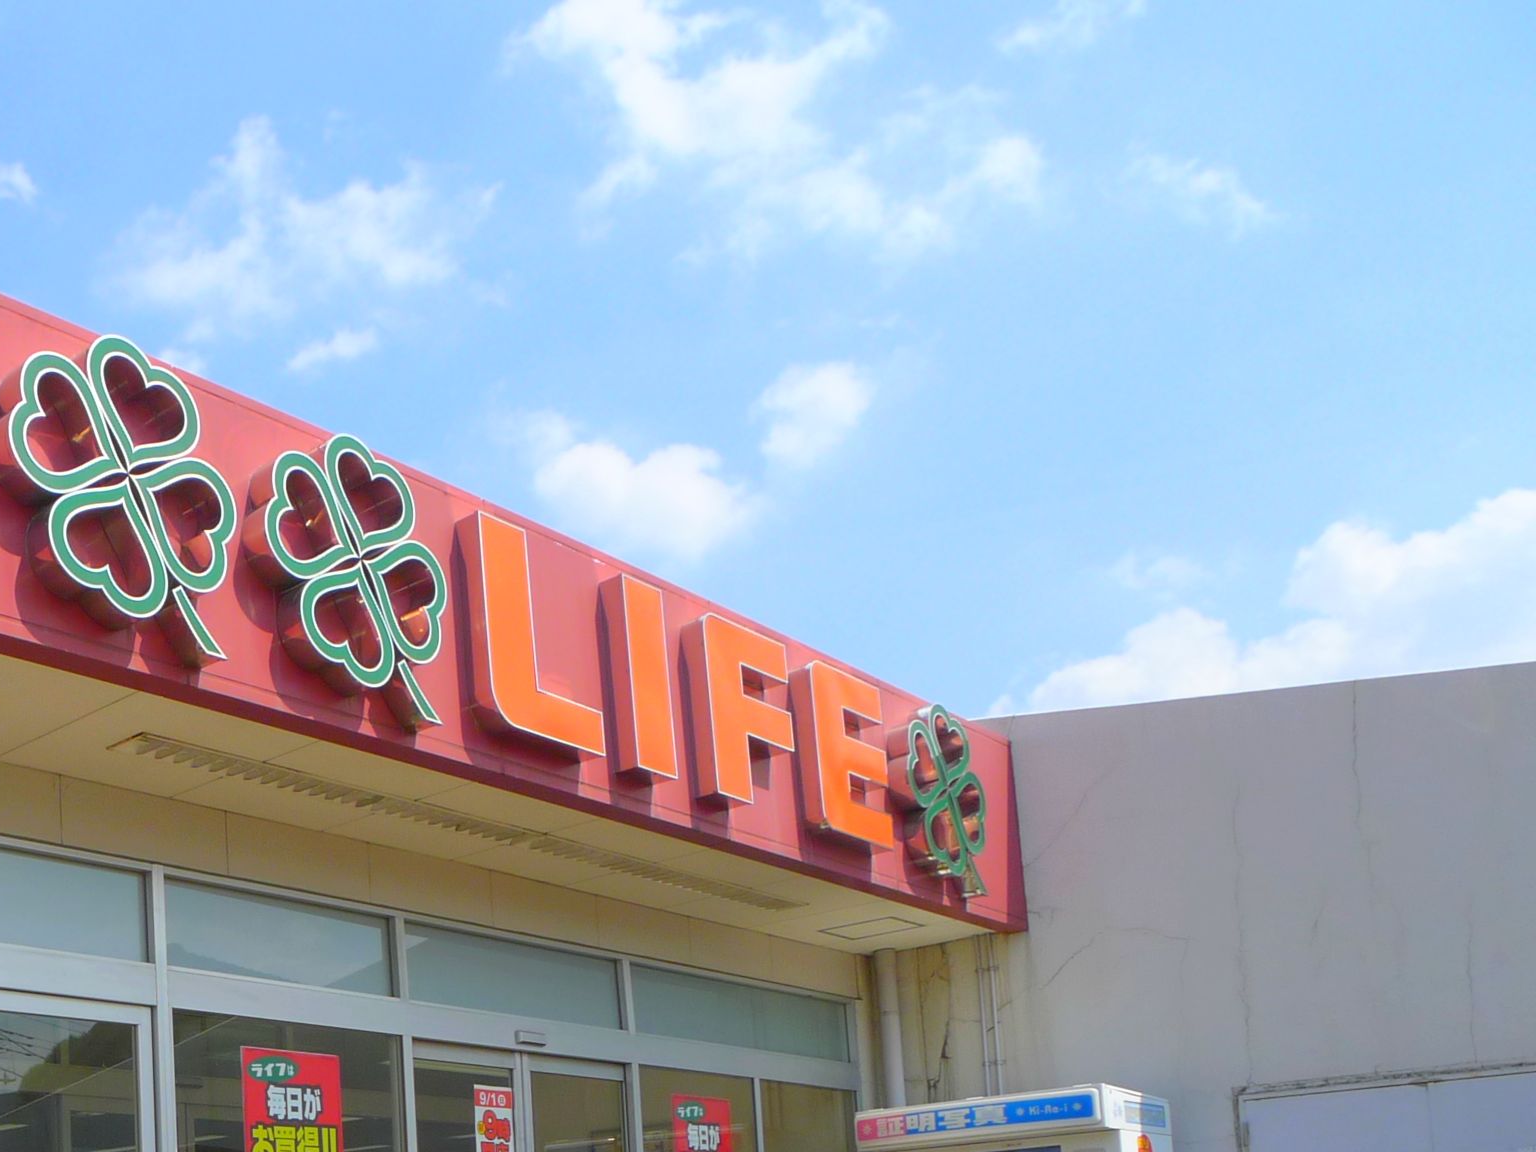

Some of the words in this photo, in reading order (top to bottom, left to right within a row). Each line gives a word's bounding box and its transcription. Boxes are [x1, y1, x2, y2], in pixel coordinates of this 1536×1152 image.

[474, 508, 894, 852] LIFE
[251, 1063, 295, 1077] ライフは
[267, 1085, 322, 1121] 毎日が
[687, 1123, 720, 1151] 毎日が
[876, 1104, 1007, 1138] 証明写真
